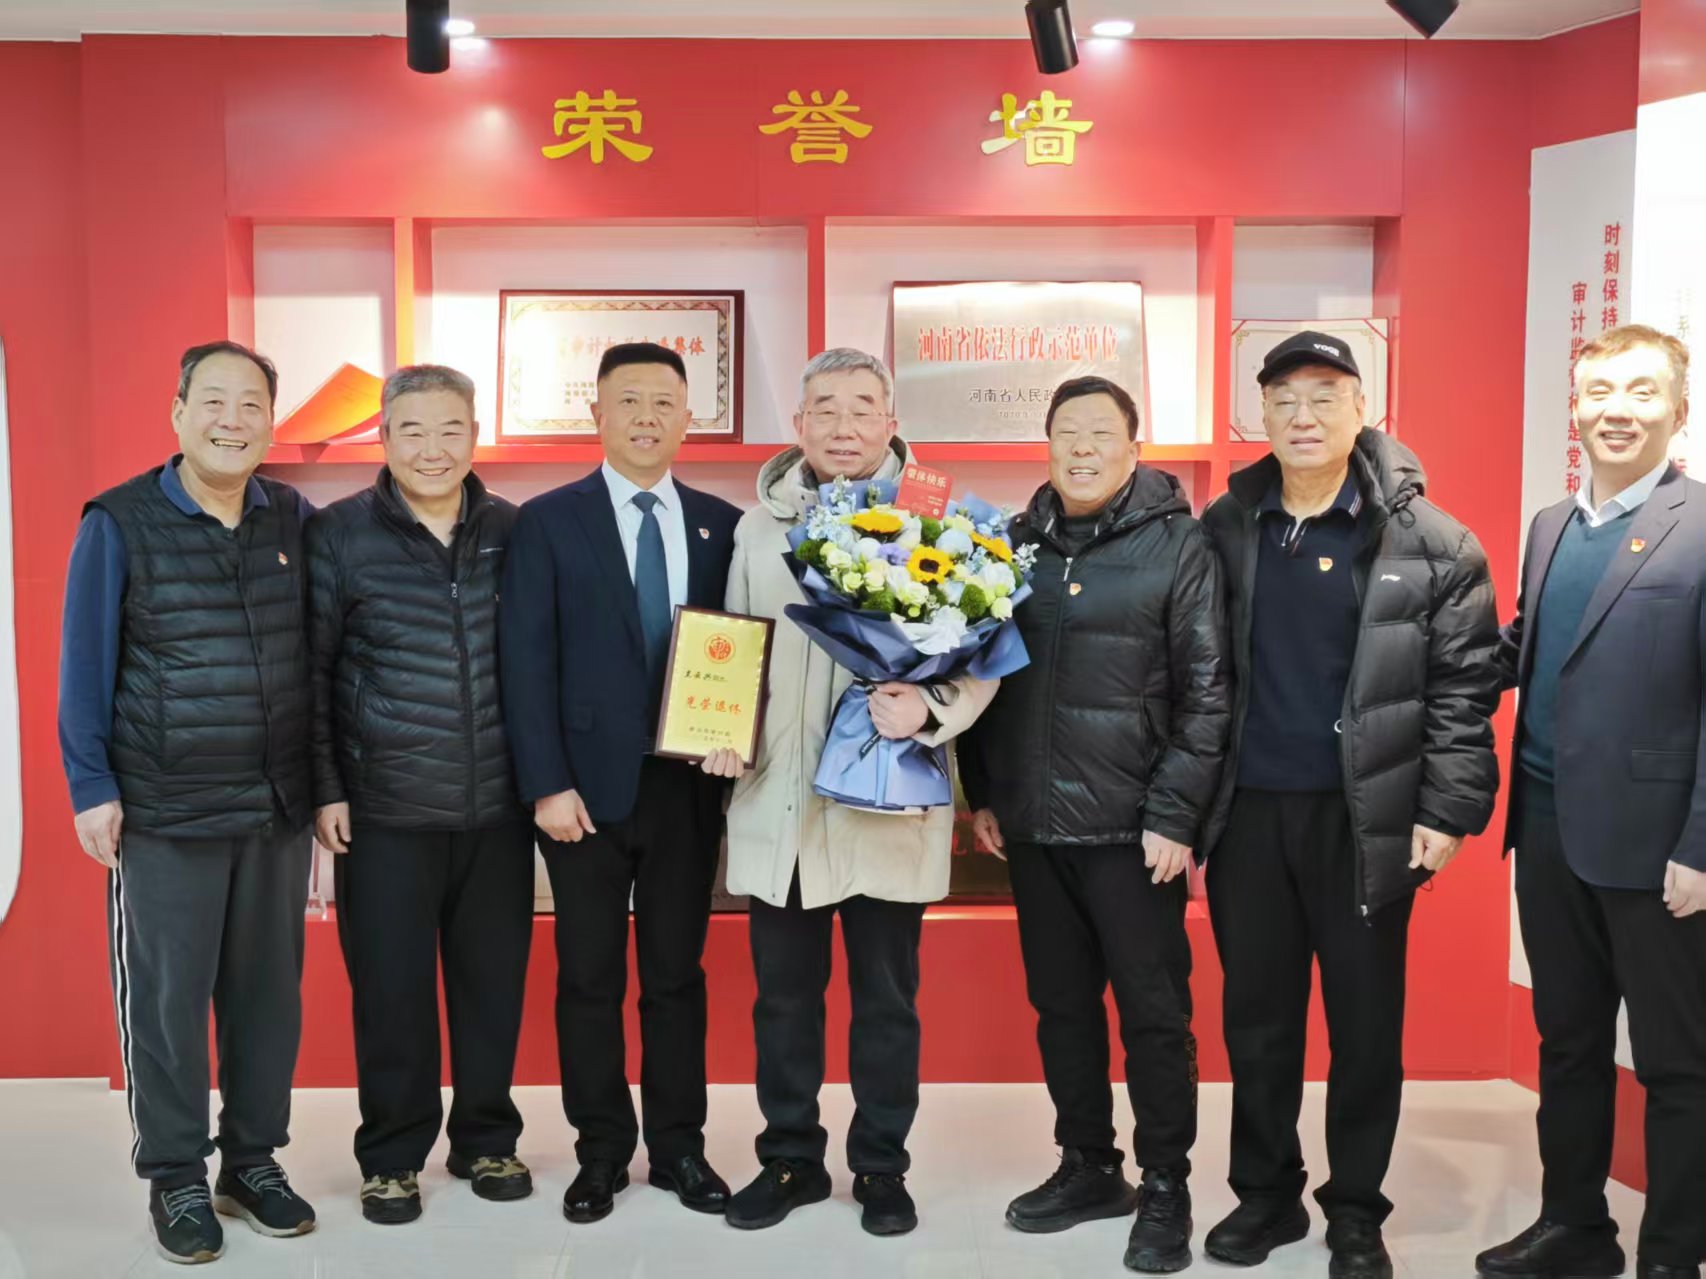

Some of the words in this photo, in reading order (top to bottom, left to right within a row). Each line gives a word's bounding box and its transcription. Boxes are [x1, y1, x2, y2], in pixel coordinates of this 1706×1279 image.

[541, 89, 1094, 166] 荣誉墙
[1602, 221, 1621, 331] 时刻保持
[918, 326, 1120, 361] 河南省依法行政示范单位
